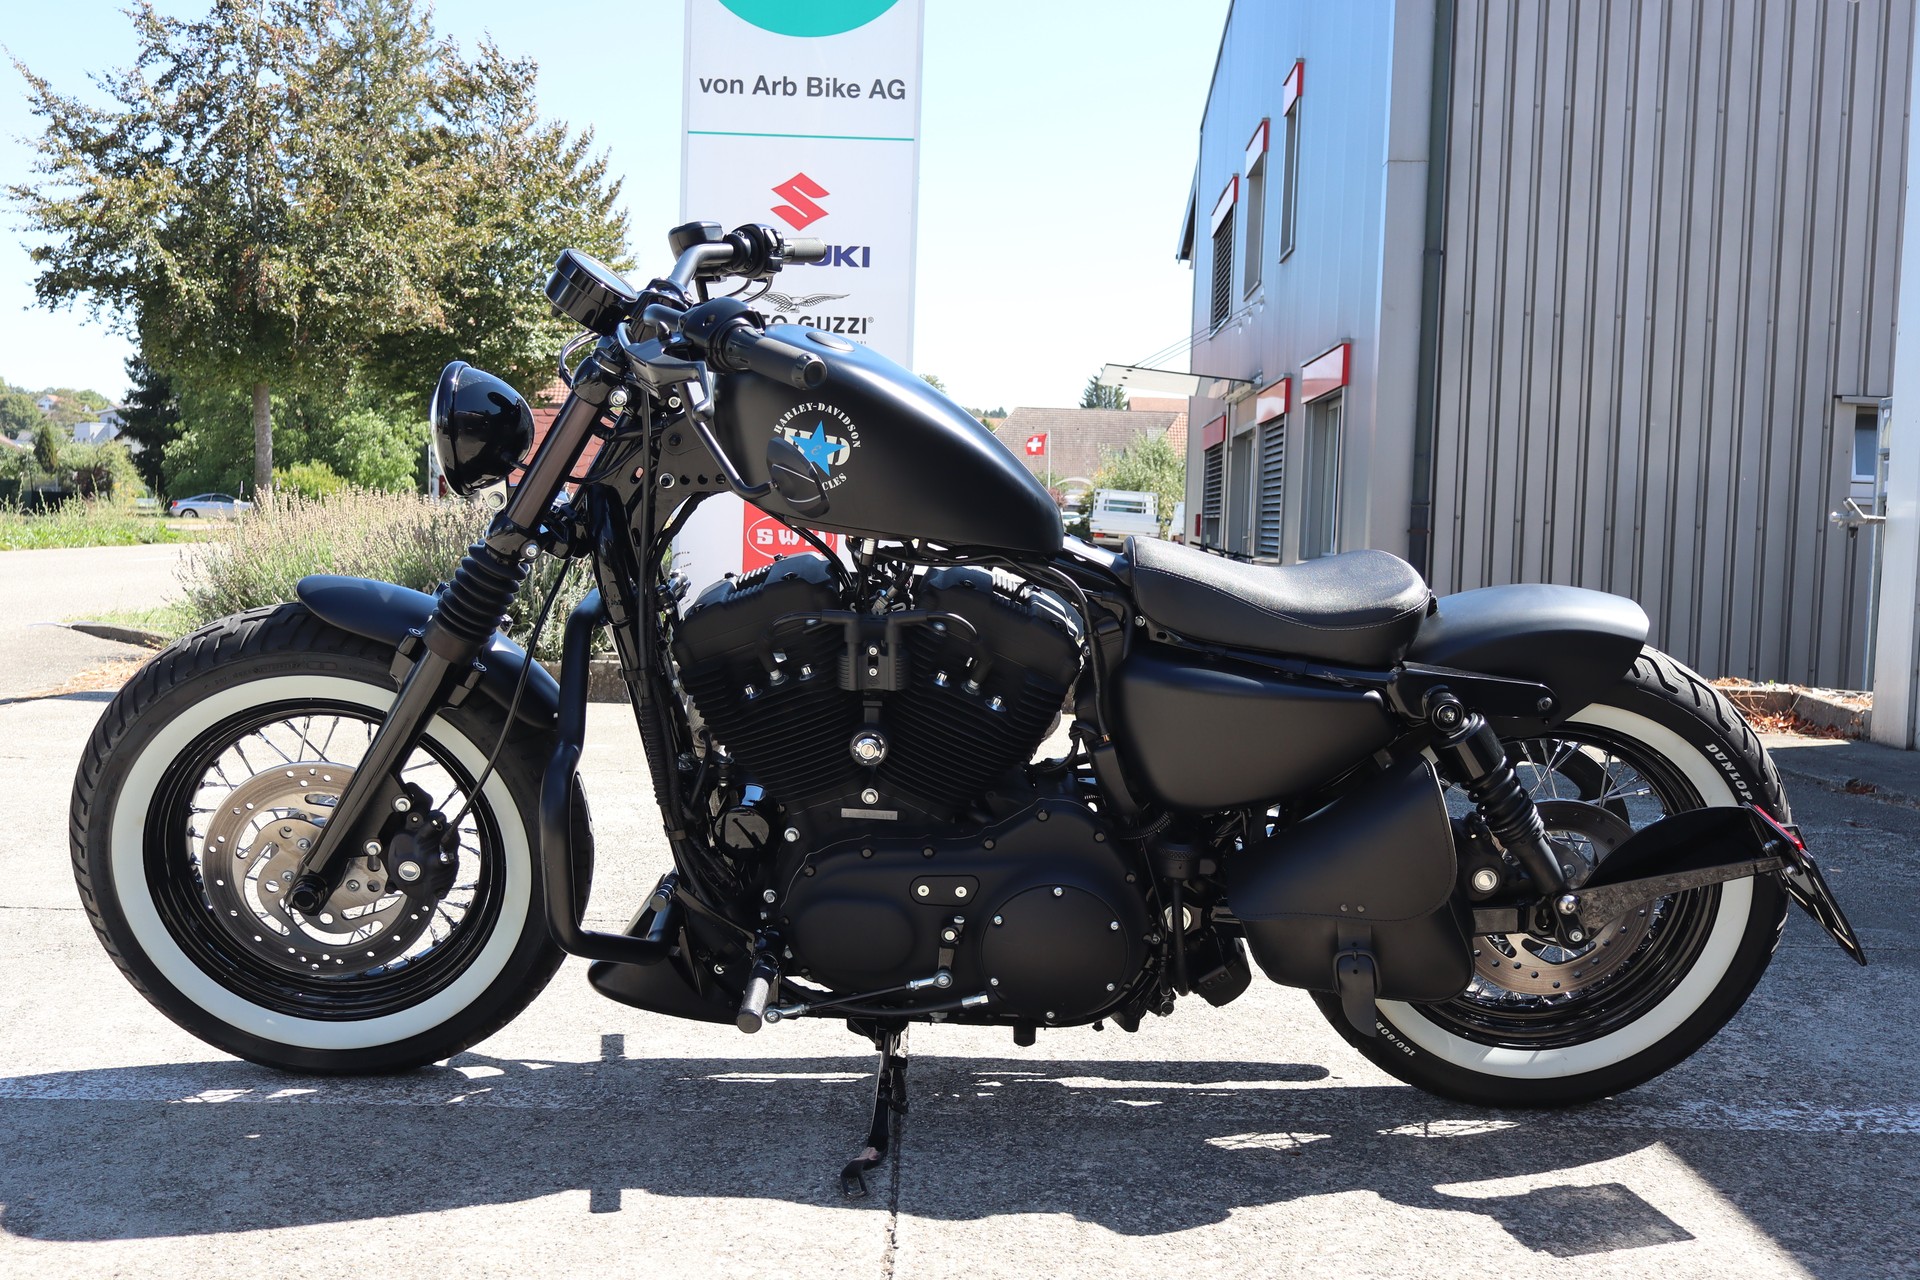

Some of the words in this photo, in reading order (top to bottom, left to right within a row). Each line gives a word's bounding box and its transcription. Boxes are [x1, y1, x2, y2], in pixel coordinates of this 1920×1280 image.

[699, 77, 744, 94] von
[752, 75, 798, 97] Arb
[806, 76, 861, 99] Bike
[868, 79, 906, 100] AG
[773, 402, 861, 448] HARLEY-DAVIDSON
[1705, 743, 1753, 800] DUNLOP
